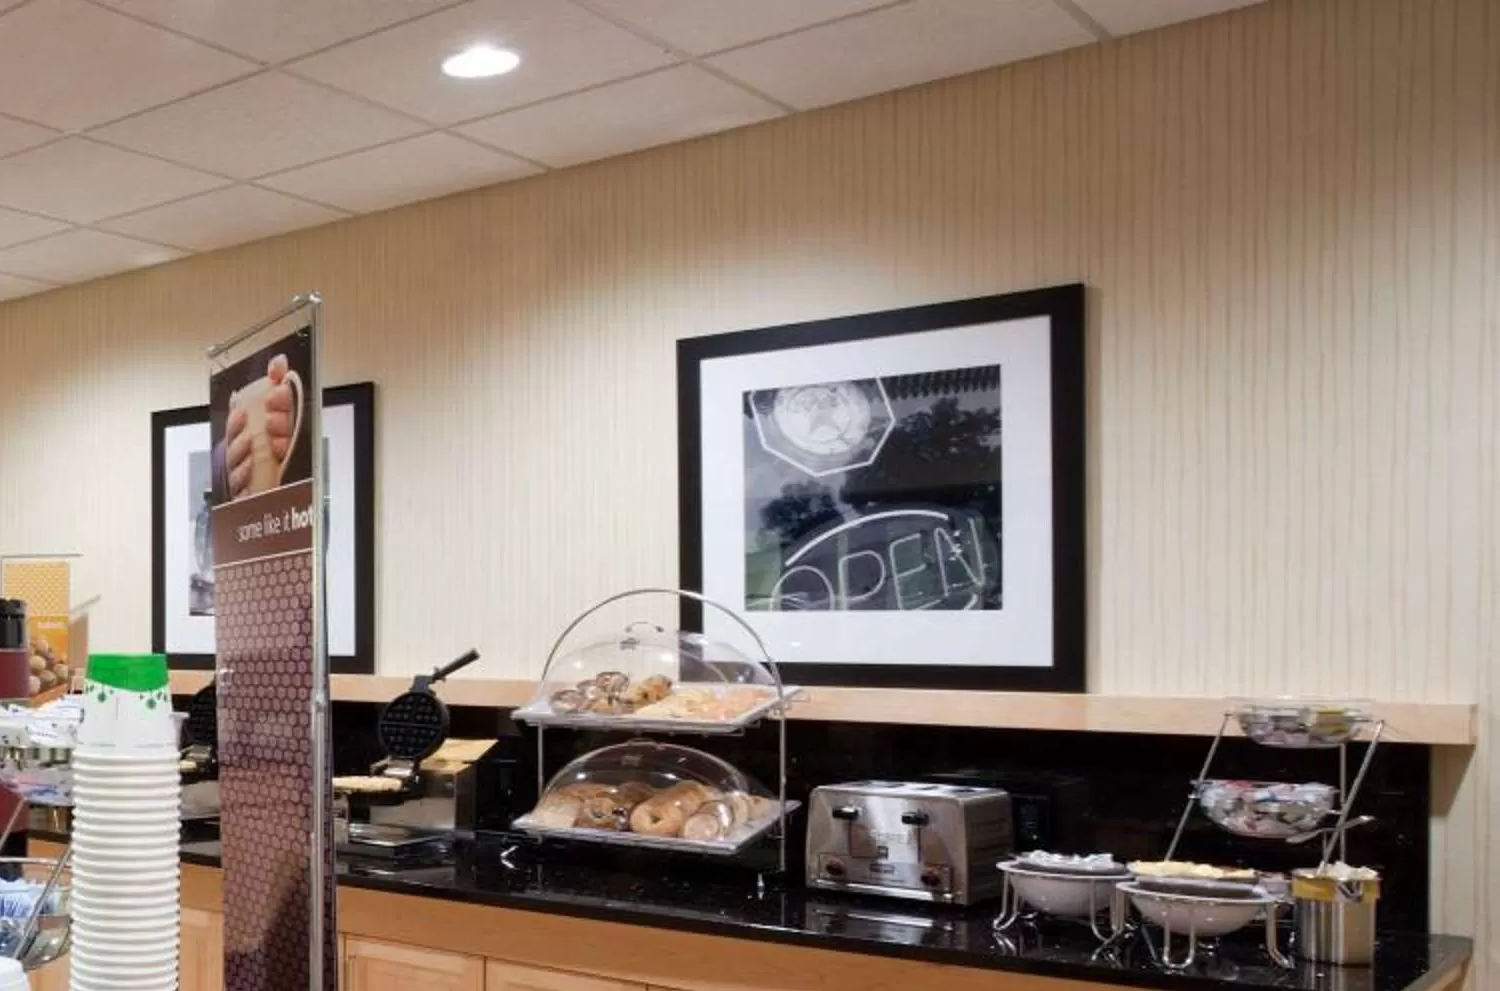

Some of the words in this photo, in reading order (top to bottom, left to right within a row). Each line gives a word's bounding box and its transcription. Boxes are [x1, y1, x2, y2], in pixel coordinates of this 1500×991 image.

[236, 521, 262, 543] some
[263, 512, 281, 536] like
[283, 508, 291, 532] it
[291, 505, 314, 531] hot
